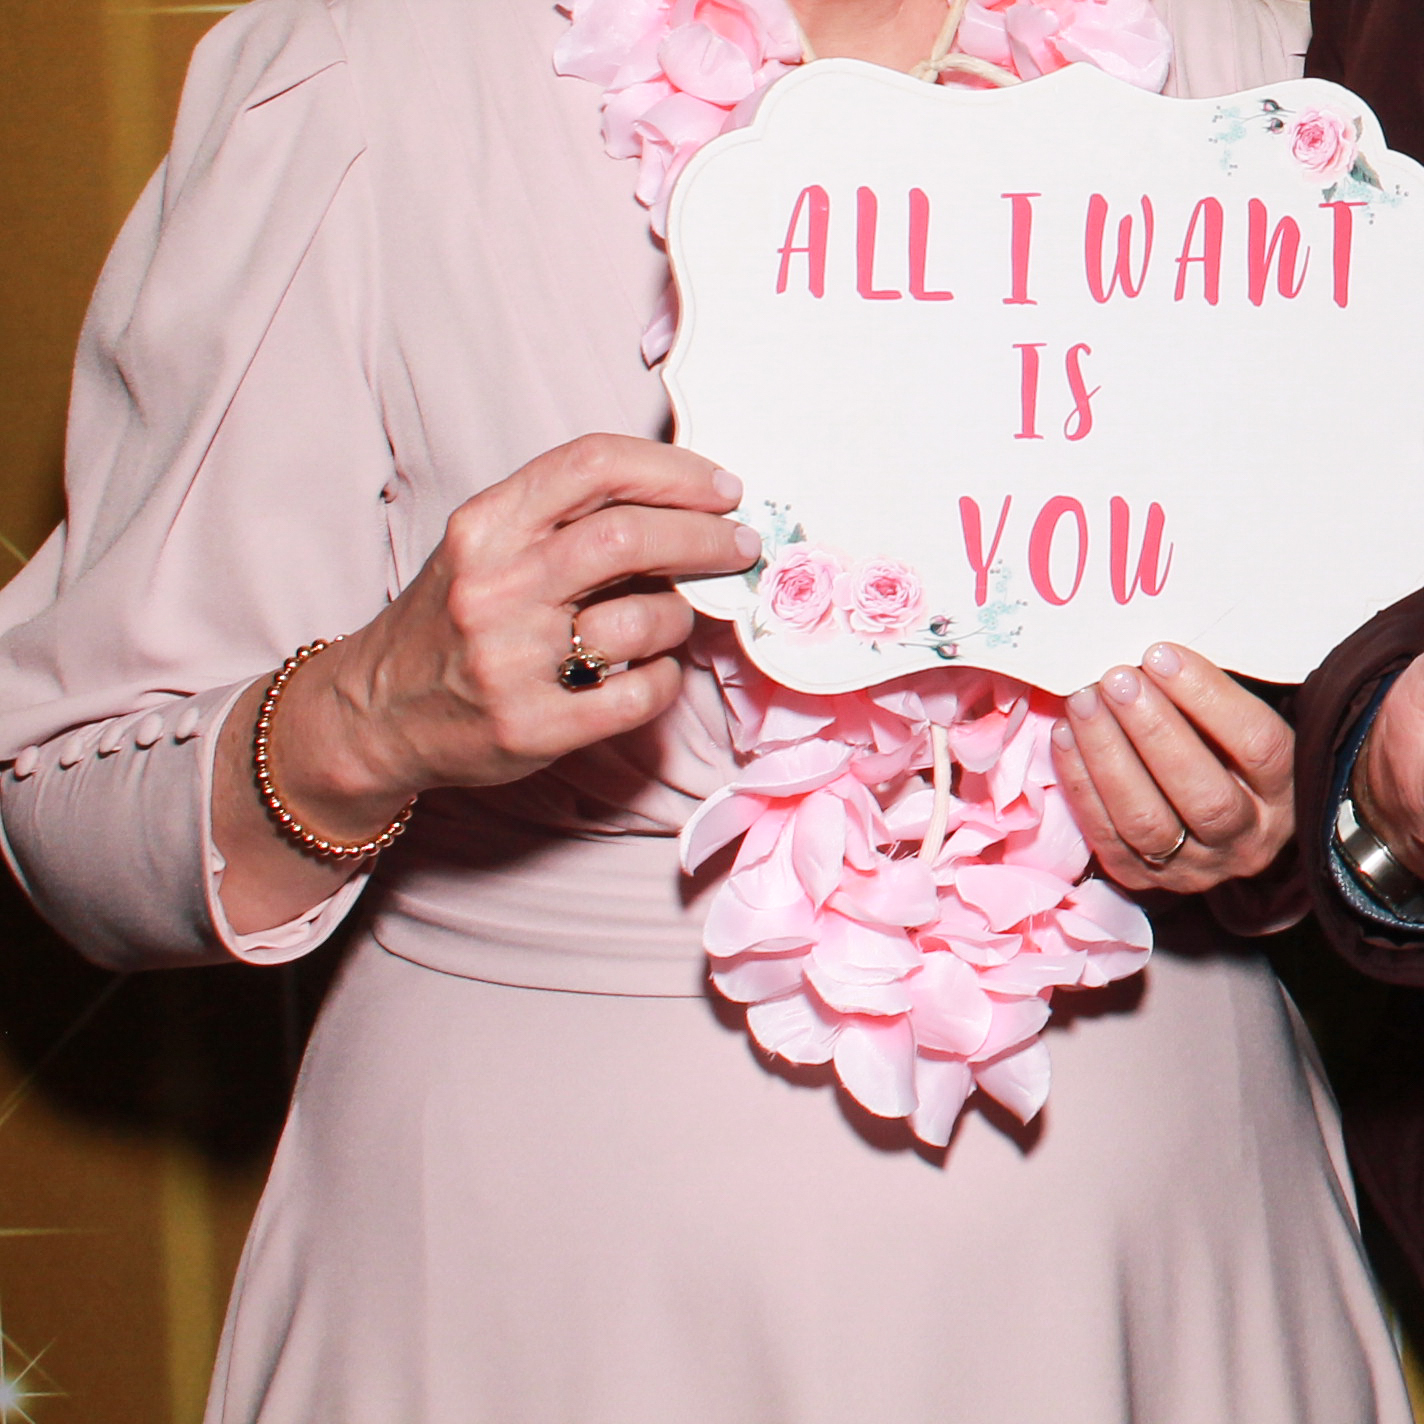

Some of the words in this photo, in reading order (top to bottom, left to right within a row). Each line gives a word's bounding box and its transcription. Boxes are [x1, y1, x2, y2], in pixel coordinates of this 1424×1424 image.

[776, 184, 955, 301] ALL
[1000, 192, 1042, 305] I
[1084, 193, 1368, 308] WANT
[1012, 342, 1101, 441] IS
[958, 494, 1174, 607] YOU
